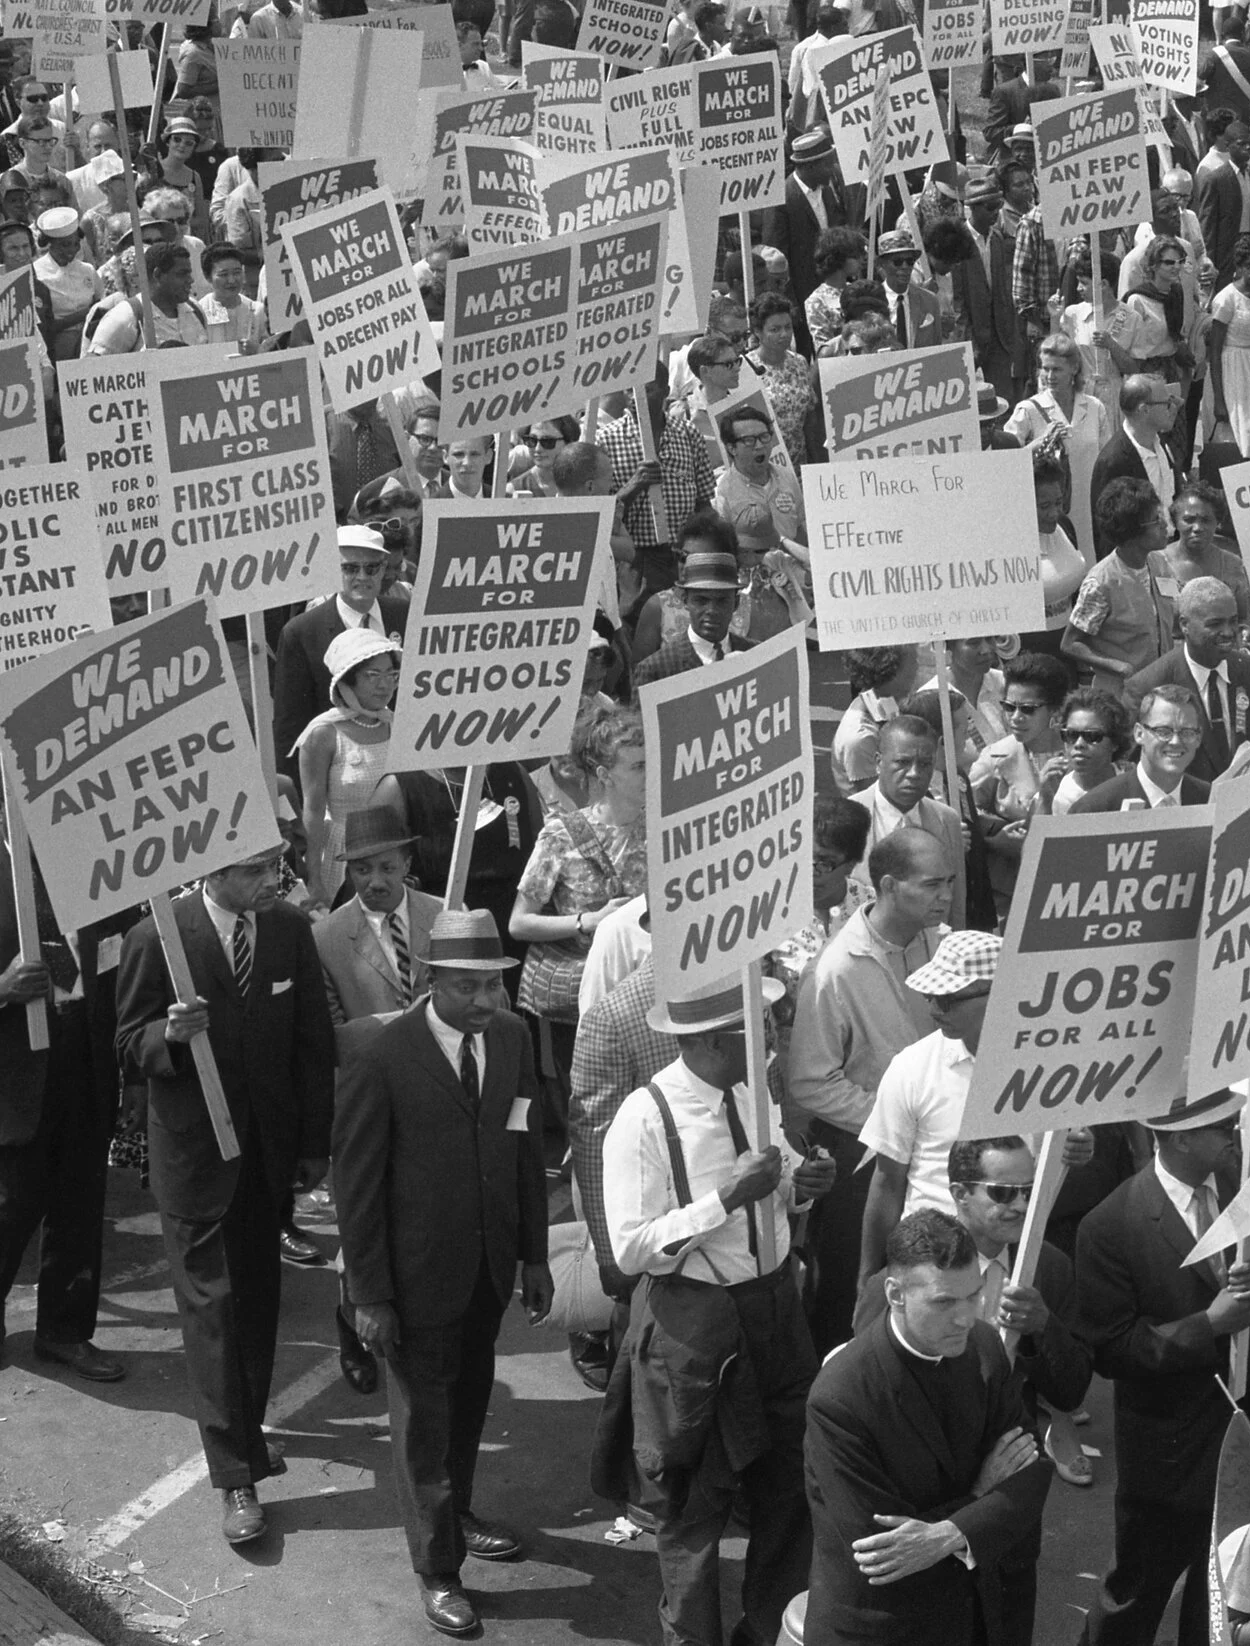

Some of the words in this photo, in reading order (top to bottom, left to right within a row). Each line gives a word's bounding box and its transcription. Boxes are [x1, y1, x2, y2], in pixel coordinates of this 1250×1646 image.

[931, 12, 975, 31] JOBS
[1138, 1, 1195, 17] DEMAND
[589, 15, 659, 41] SCHOOLS
[1138, 24, 1193, 48] VOTING
[588, 35, 652, 61] NOW!
[1141, 41, 1190, 64] RIGHTS
[1140, 58, 1192, 83] NOW!
[640, 102, 677, 120] PLUS
[641, 116, 683, 138] FULL
[1068, 101, 1103, 131] WE
[1046, 111, 1135, 160] DEMAND
[1049, 163, 1080, 184] AN
[1089, 152, 1140, 175] FEPC
[1071, 176, 1124, 199] LAW
[1060, 190, 1141, 227] NOW!
[310, 232, 392, 282] MARCH
[337, 316, 391, 352] DECENT
[391, 303, 419, 331] PAY
[346, 331, 422, 394] NOW!
[216, 374, 260, 403] WE
[178, 395, 301, 446] MARCH
[222, 437, 270, 458] FOR
[173, 475, 243, 513] FIRST
[251, 460, 320, 498] CLASS
[171, 492, 326, 547] CITIZENSHIP
[498, 523, 543, 548] WE
[195, 532, 320, 597] NOW!
[442, 552, 582, 588] MARCH
[828, 568, 883, 598] CIVIL
[884, 563, 943, 595] RIGHTS
[949, 558, 998, 590] LAWS
[1003, 556, 1040, 583] NOW
[482, 590, 535, 606] FOR
[419, 617, 581, 655] INTEGRATED
[850, 614, 897, 634] UNITED
[72, 639, 142, 708] WE
[413, 658, 571, 698] SCHOOLS
[35, 646, 210, 781] DEMAND
[415, 695, 562, 751] NOW!
[51, 770, 117, 825] AN
[126, 721, 235, 792] FEPC
[99, 770, 209, 843] LAW
[89, 791, 248, 900] NOW!
[1106, 839, 1158, 872] WE
[1040, 872, 1197, 920] MARCH
[1083, 920, 1143, 942] FOR
[1018, 959, 1175, 1019] JOBS
[1013, 1026, 1080, 1050] FOR
[1099, 1018, 1157, 1041] ALL
[994, 1046, 1163, 1114] NOW!
